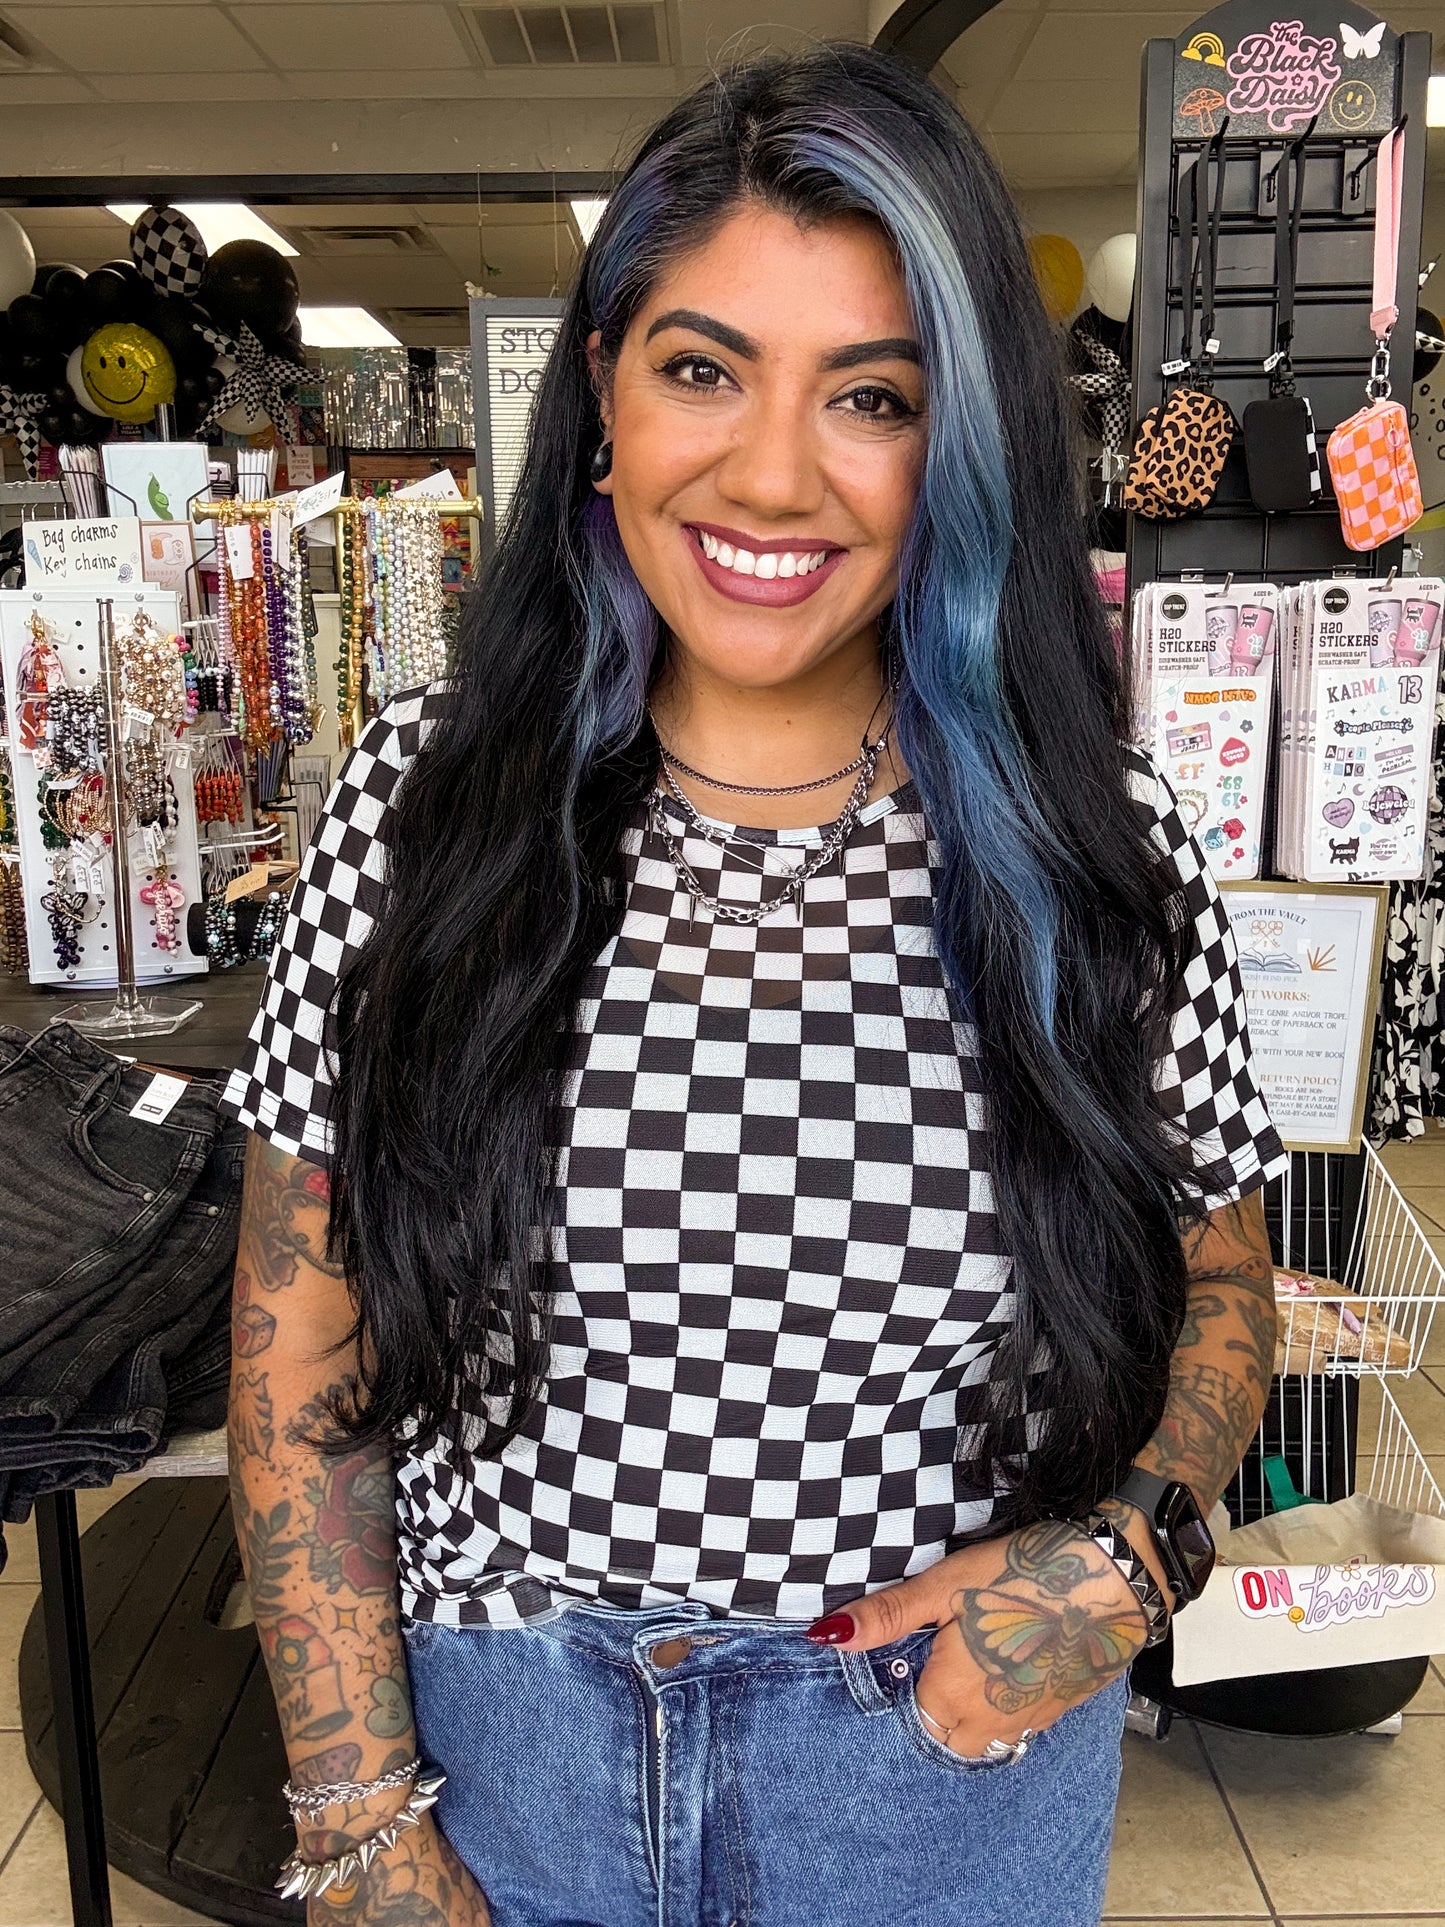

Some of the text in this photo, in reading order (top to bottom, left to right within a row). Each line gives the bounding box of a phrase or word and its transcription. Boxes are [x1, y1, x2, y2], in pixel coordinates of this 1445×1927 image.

[1230, 38, 1338, 79] Black
[1230, 76, 1330, 127] Daisy
[42, 528, 65, 553] Bag
[43, 552, 117, 578] Key chains
[1159, 640, 1217, 653] STICKERS
[1319, 634, 1379, 647] STICKERS
[1183, 688, 1257, 705] CALM DOWN
[1326, 675, 1387, 704] KARMA
[1398, 675, 1423, 704] 13
[1342, 720, 1404, 735] People Pleaser
[1178, 763, 1201, 780] 13
[1323, 762, 1365, 777] HRO
[1229, 908, 1308, 926] FROM THE VAULT
[1261, 990, 1310, 1002] WORKS:
[1271, 1019, 1280, 1027] OF
[1283, 1020, 1324, 1029] PAPERBACK
[1326, 1022, 1337, 1030] OR
[1262, 1047, 1282, 1056] WITH
[1284, 1049, 1304, 1057] YOUR
[1305, 1050, 1323, 1058] NEW
[1260, 1074, 1300, 1084] RETURN
[1241, 1563, 1427, 1625] ON books
